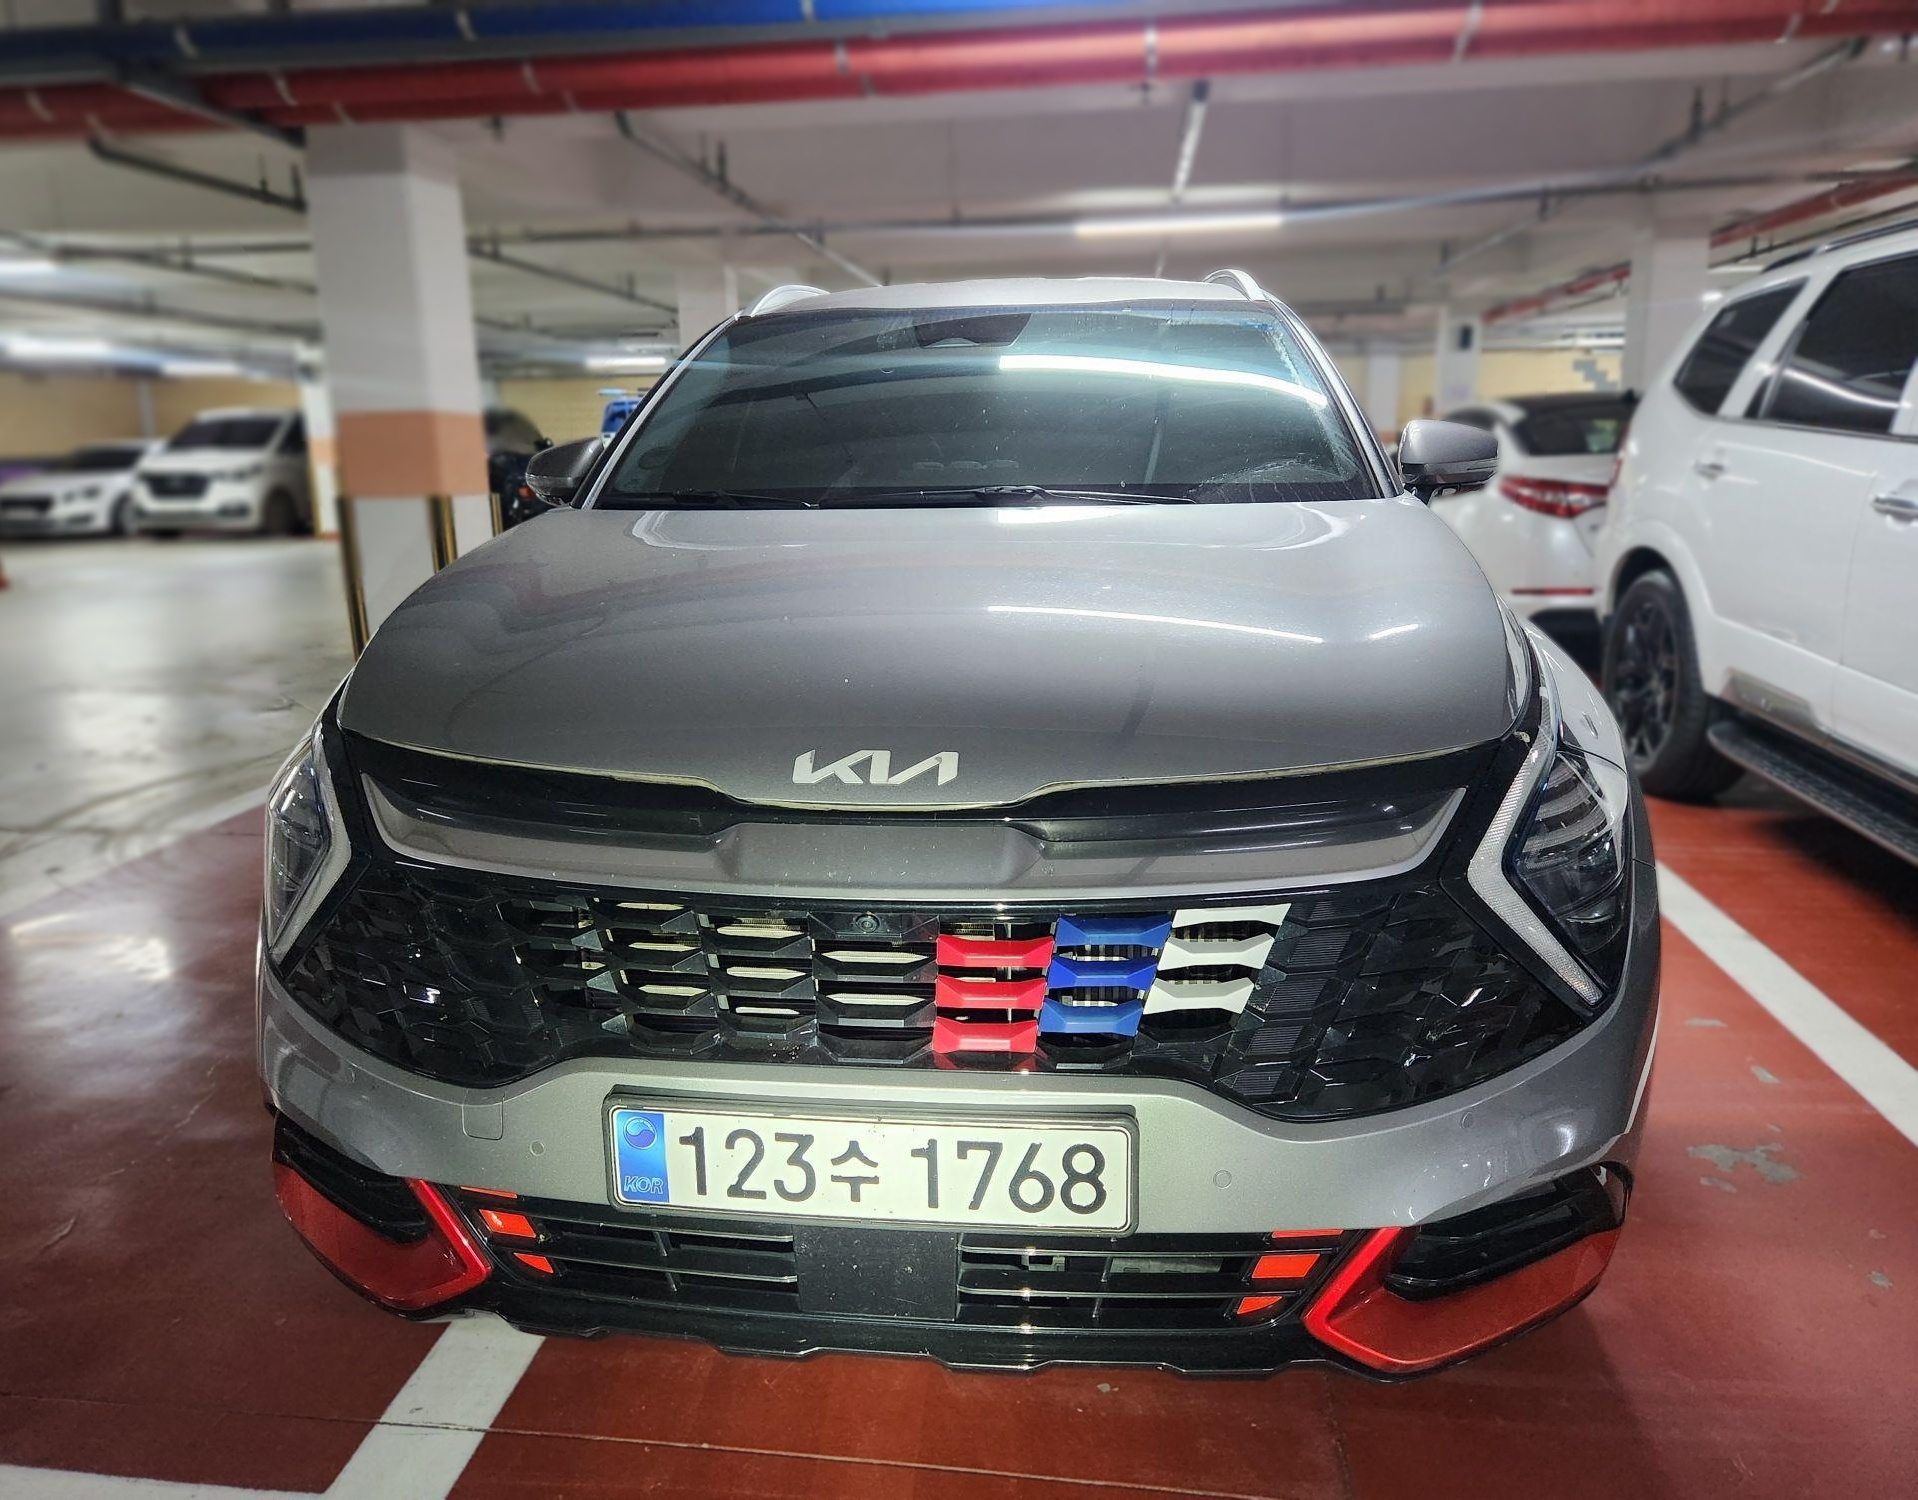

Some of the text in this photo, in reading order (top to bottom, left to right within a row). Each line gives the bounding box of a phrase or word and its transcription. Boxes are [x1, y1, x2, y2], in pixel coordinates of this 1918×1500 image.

[792, 749, 959, 785] KIA
[623, 1175, 664, 1194] KOR
[678, 1126, 1107, 1215] 123수 1768
